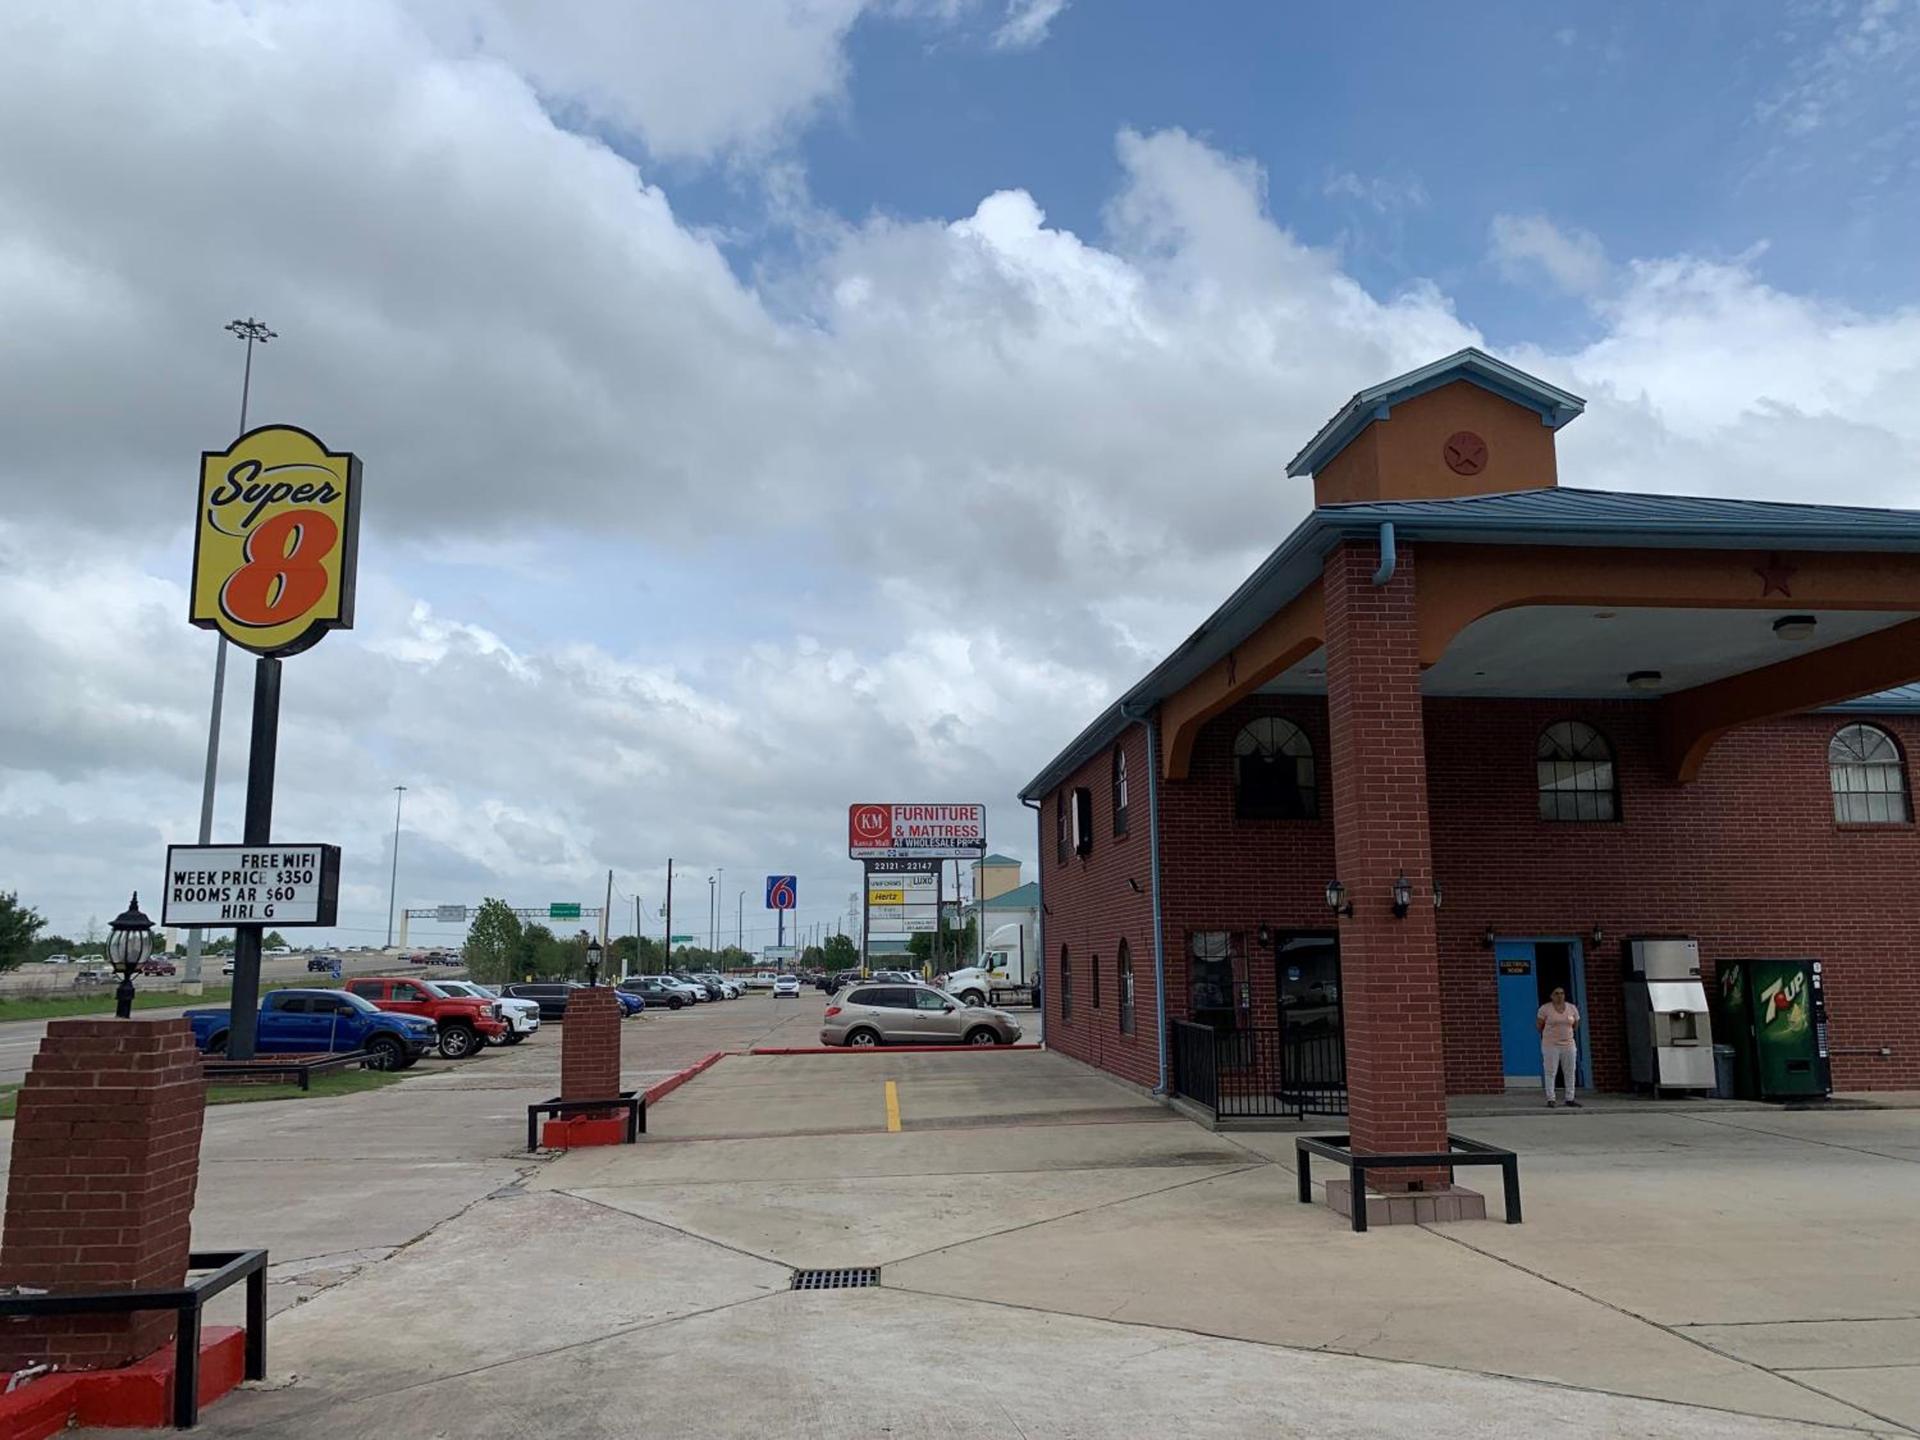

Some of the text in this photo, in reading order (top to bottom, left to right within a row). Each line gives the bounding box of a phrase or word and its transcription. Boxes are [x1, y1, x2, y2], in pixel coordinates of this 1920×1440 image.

[211, 460, 341, 528] Super
[219, 510, 339, 628] 8
[861, 814, 882, 829] KM
[895, 807, 978, 821] FURNITURE
[895, 825, 978, 837] & MATTRESS
[893, 838, 904, 848] AT
[906, 838, 954, 848] WHOLESALE
[241, 854, 315, 869] FREE WIFI
[874, 862, 899, 870] 22121
[906, 862, 932, 870] 22147
[174, 870, 313, 886] WEEK PRICE $350
[173, 887, 295, 902] ROOMS AR $60
[770, 877, 794, 909] 6
